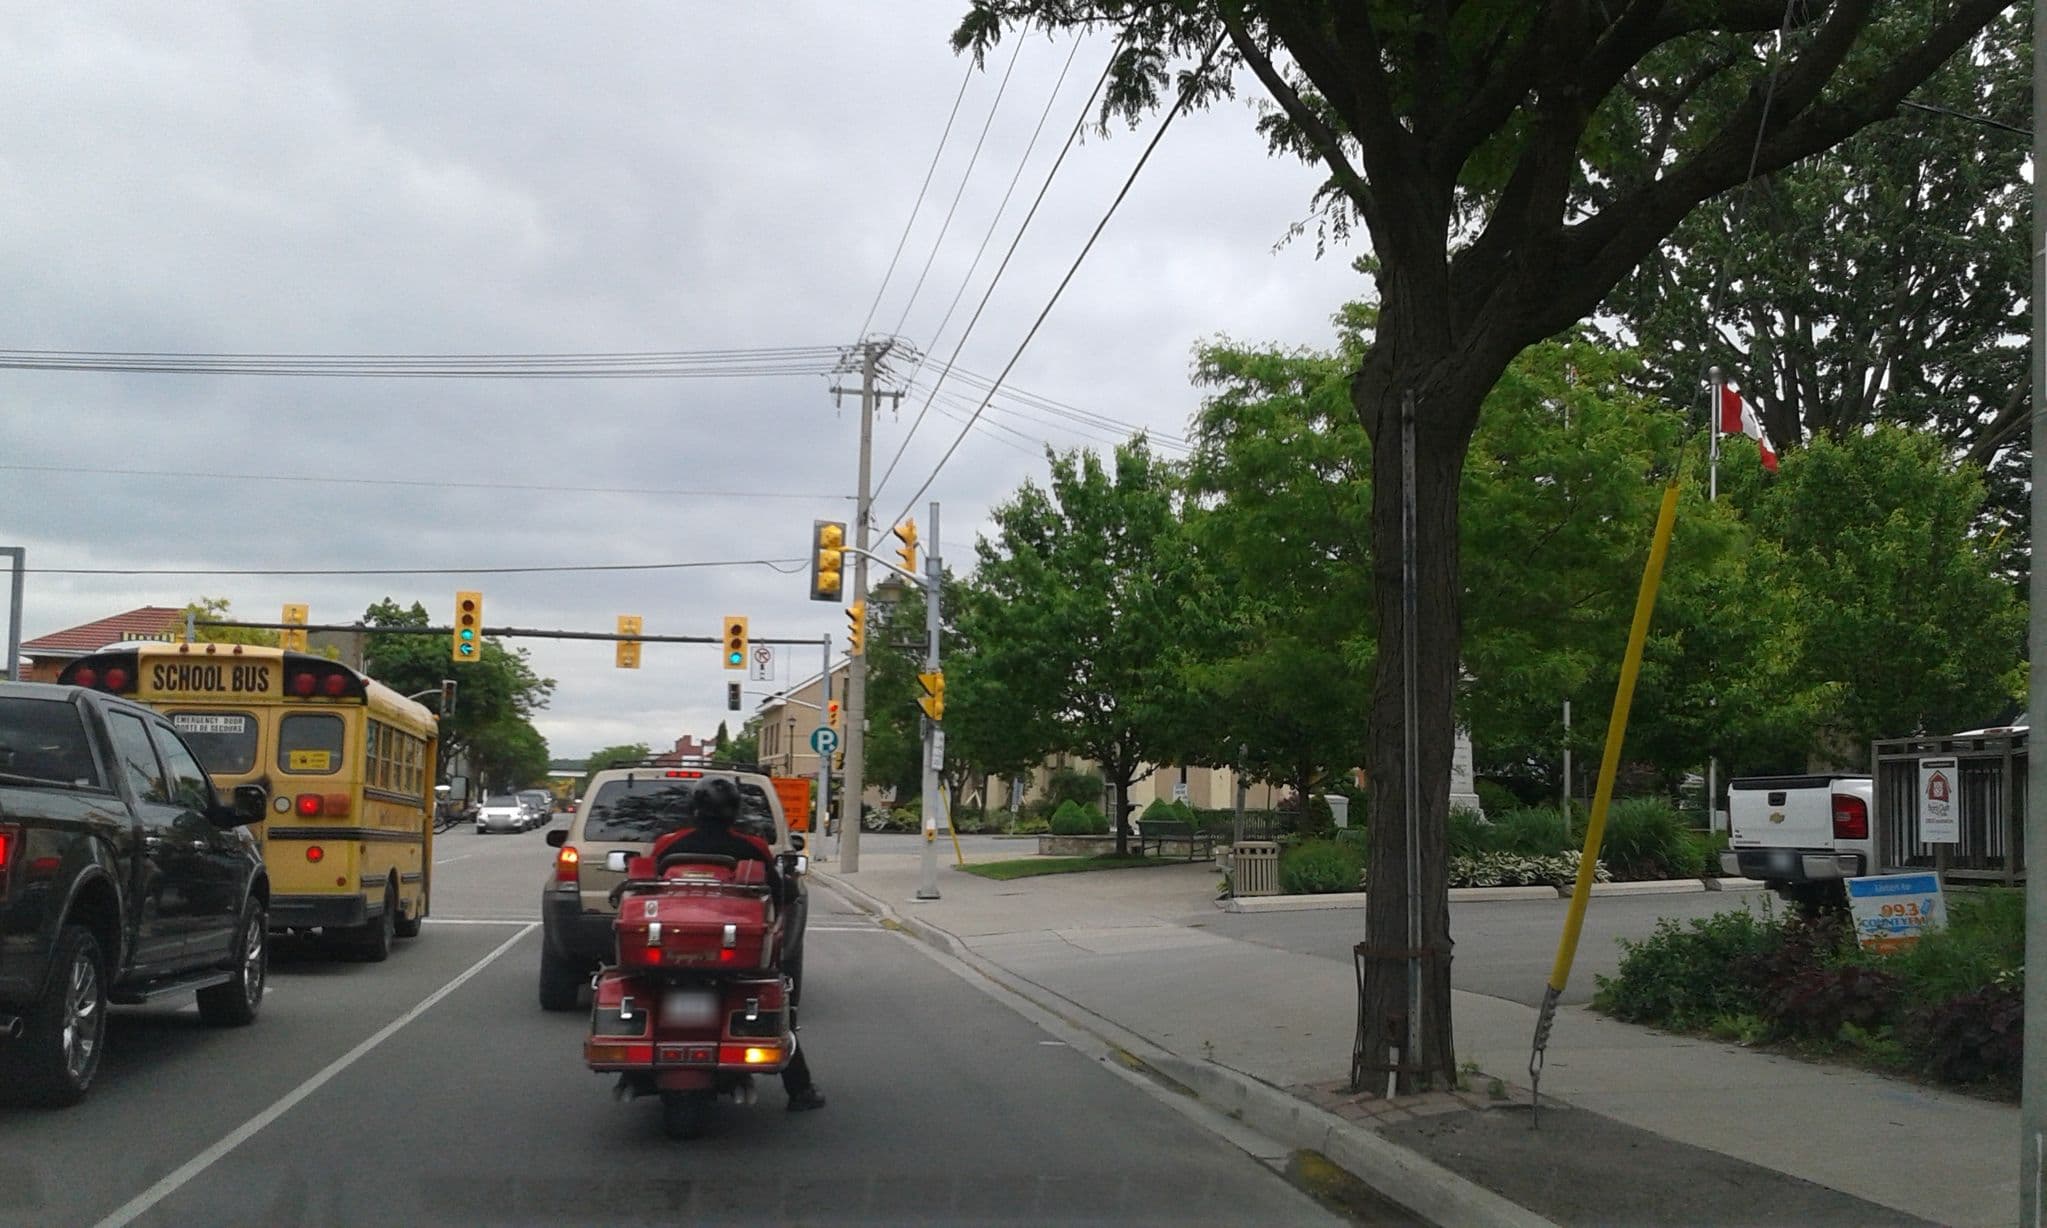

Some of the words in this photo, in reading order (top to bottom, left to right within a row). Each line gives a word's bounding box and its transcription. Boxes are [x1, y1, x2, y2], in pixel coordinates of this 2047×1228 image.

[153, 663, 226, 691] SCHOOL
[232, 665, 270, 692] BUS
[175, 715, 218, 724] EMERGENCY
[211, 724, 243, 732] SECOURS
[817, 730, 835, 752] P
[1881, 903, 1919, 917] 99.3
